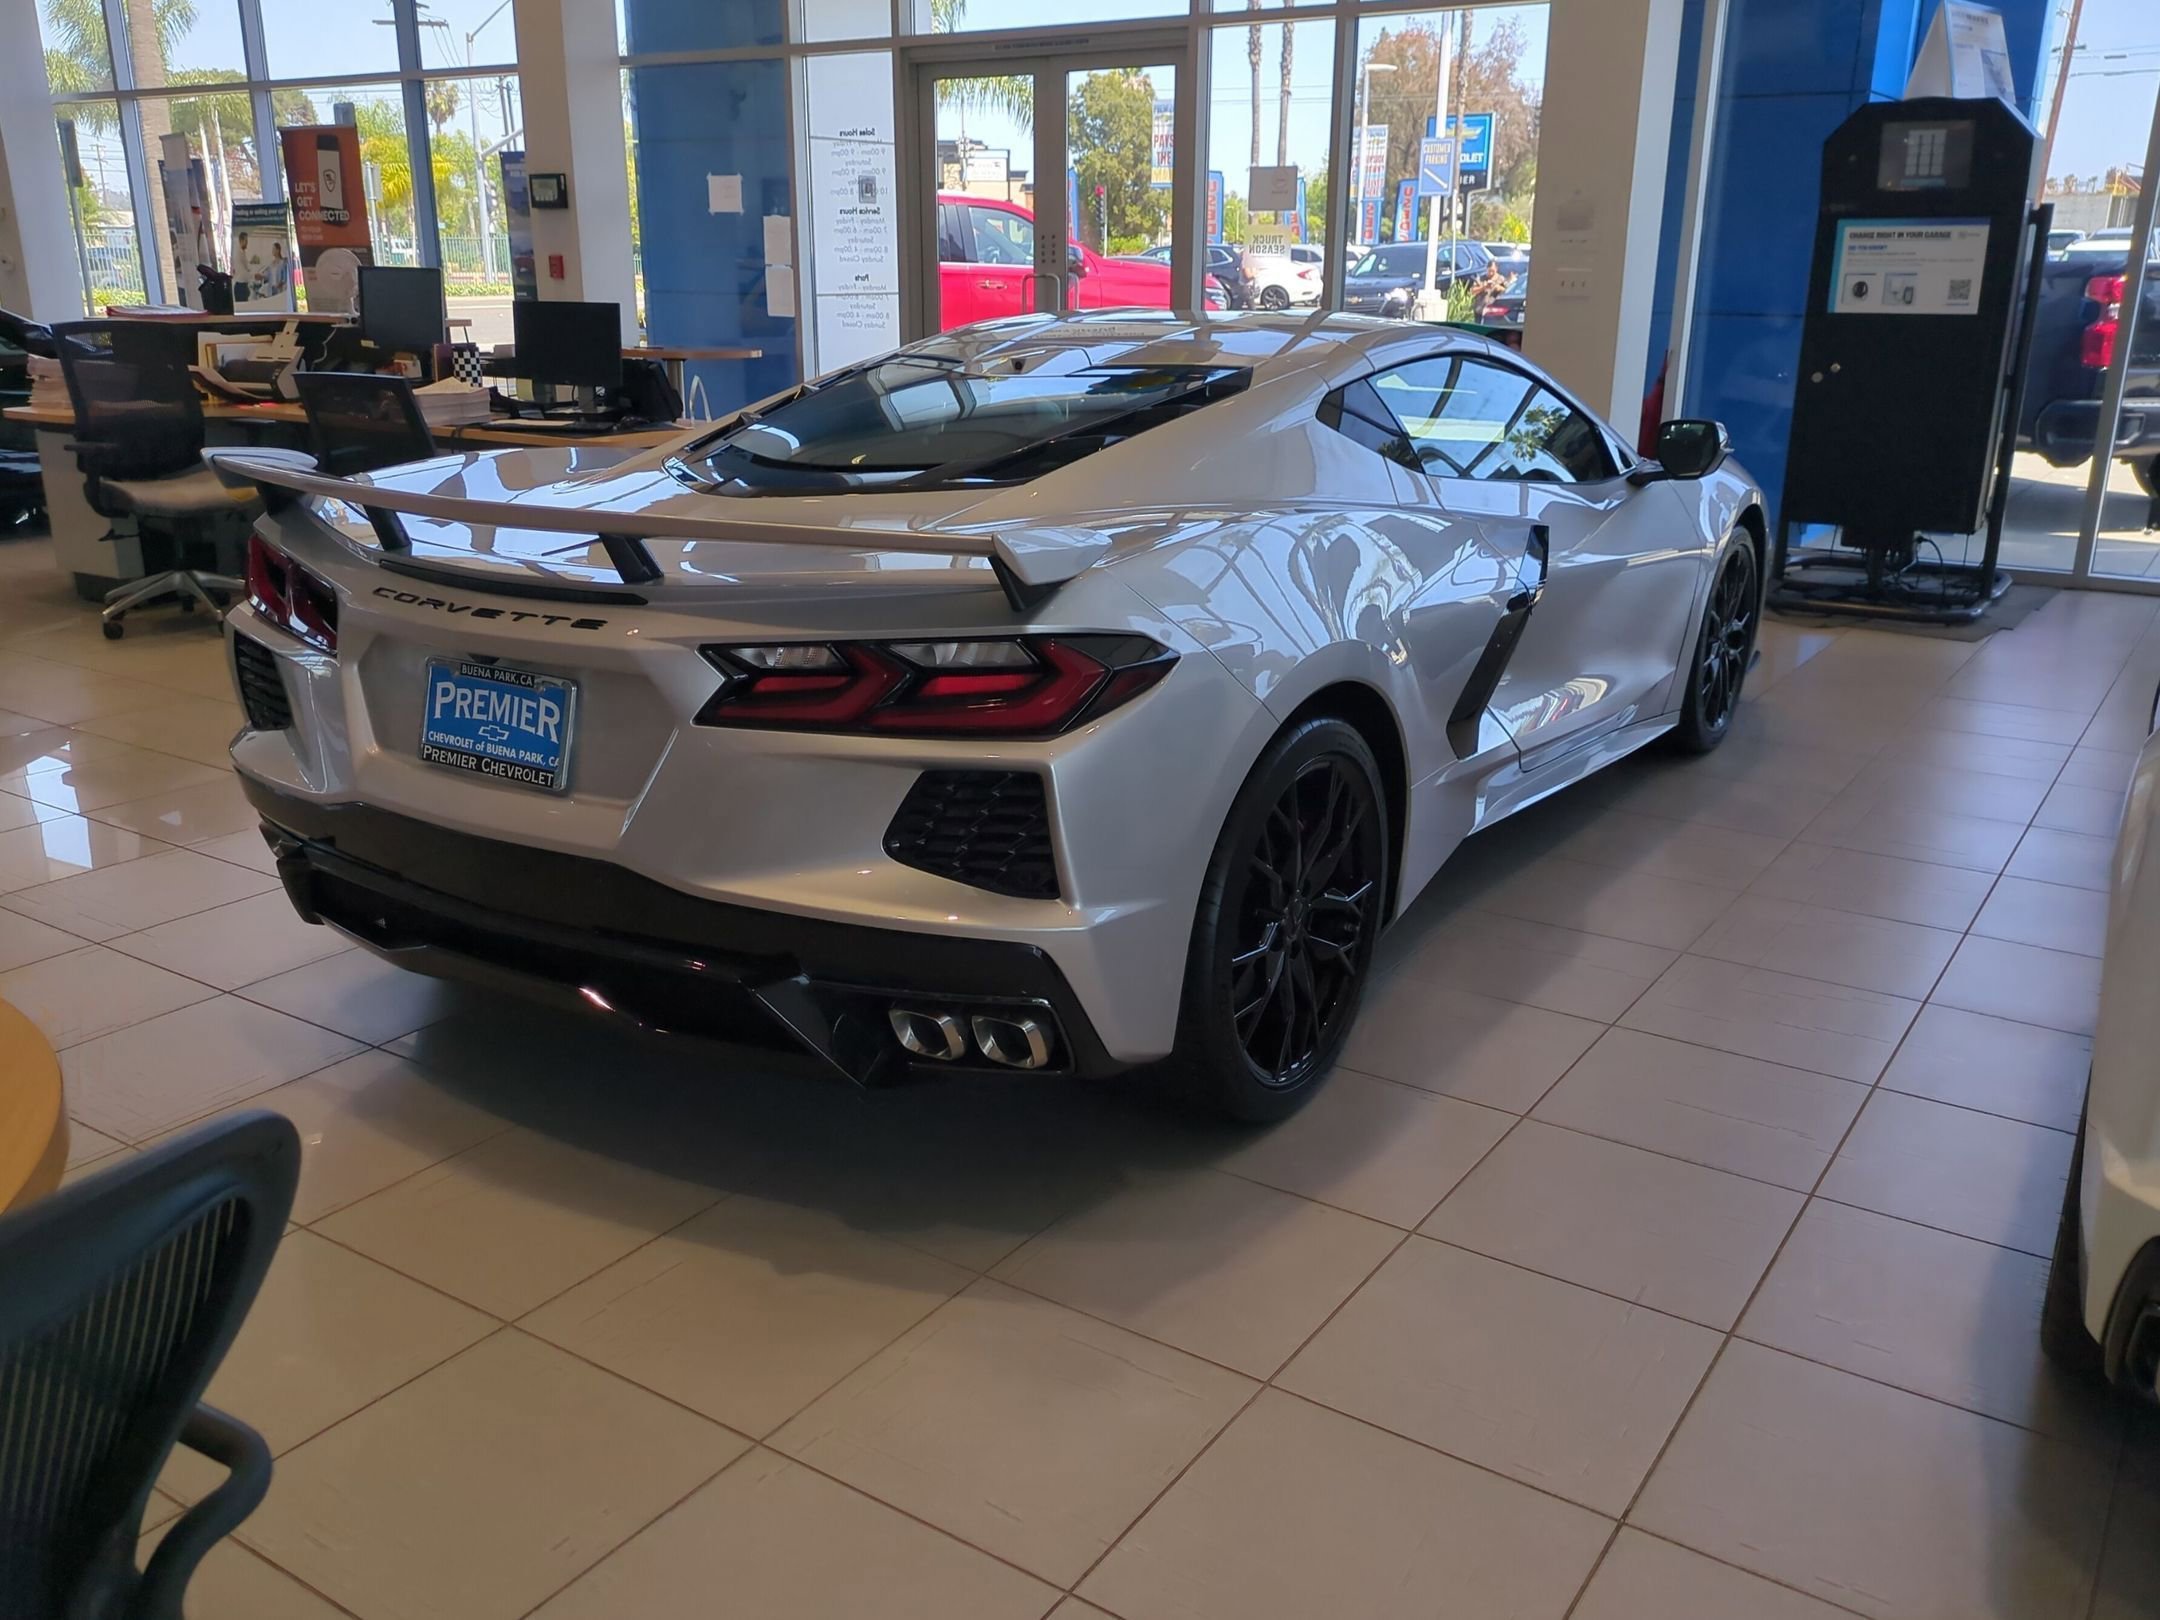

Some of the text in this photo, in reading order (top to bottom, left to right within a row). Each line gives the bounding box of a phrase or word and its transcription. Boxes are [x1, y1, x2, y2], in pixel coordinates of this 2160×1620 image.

[1153, 134, 1174, 148] PAYS
[1157, 151, 1172, 165] THE
[295, 182, 316, 193] LET'S
[297, 196, 313, 207] GET
[298, 210, 351, 222] CONNECTED
[1905, 231, 1924, 239] YOUR
[372, 586, 609, 630] CORVETTE
[462, 665, 492, 679] BUENA
[520, 675, 533, 686] CA
[433, 681, 561, 745] PREMIER
[428, 730, 474, 749] CHEVROLET
[475, 740, 485, 751] of
[486, 743, 517, 759] BUENA
[519, 750, 546, 766] PARK,
[422, 745, 554, 786] PREMIER CHEVROLET
